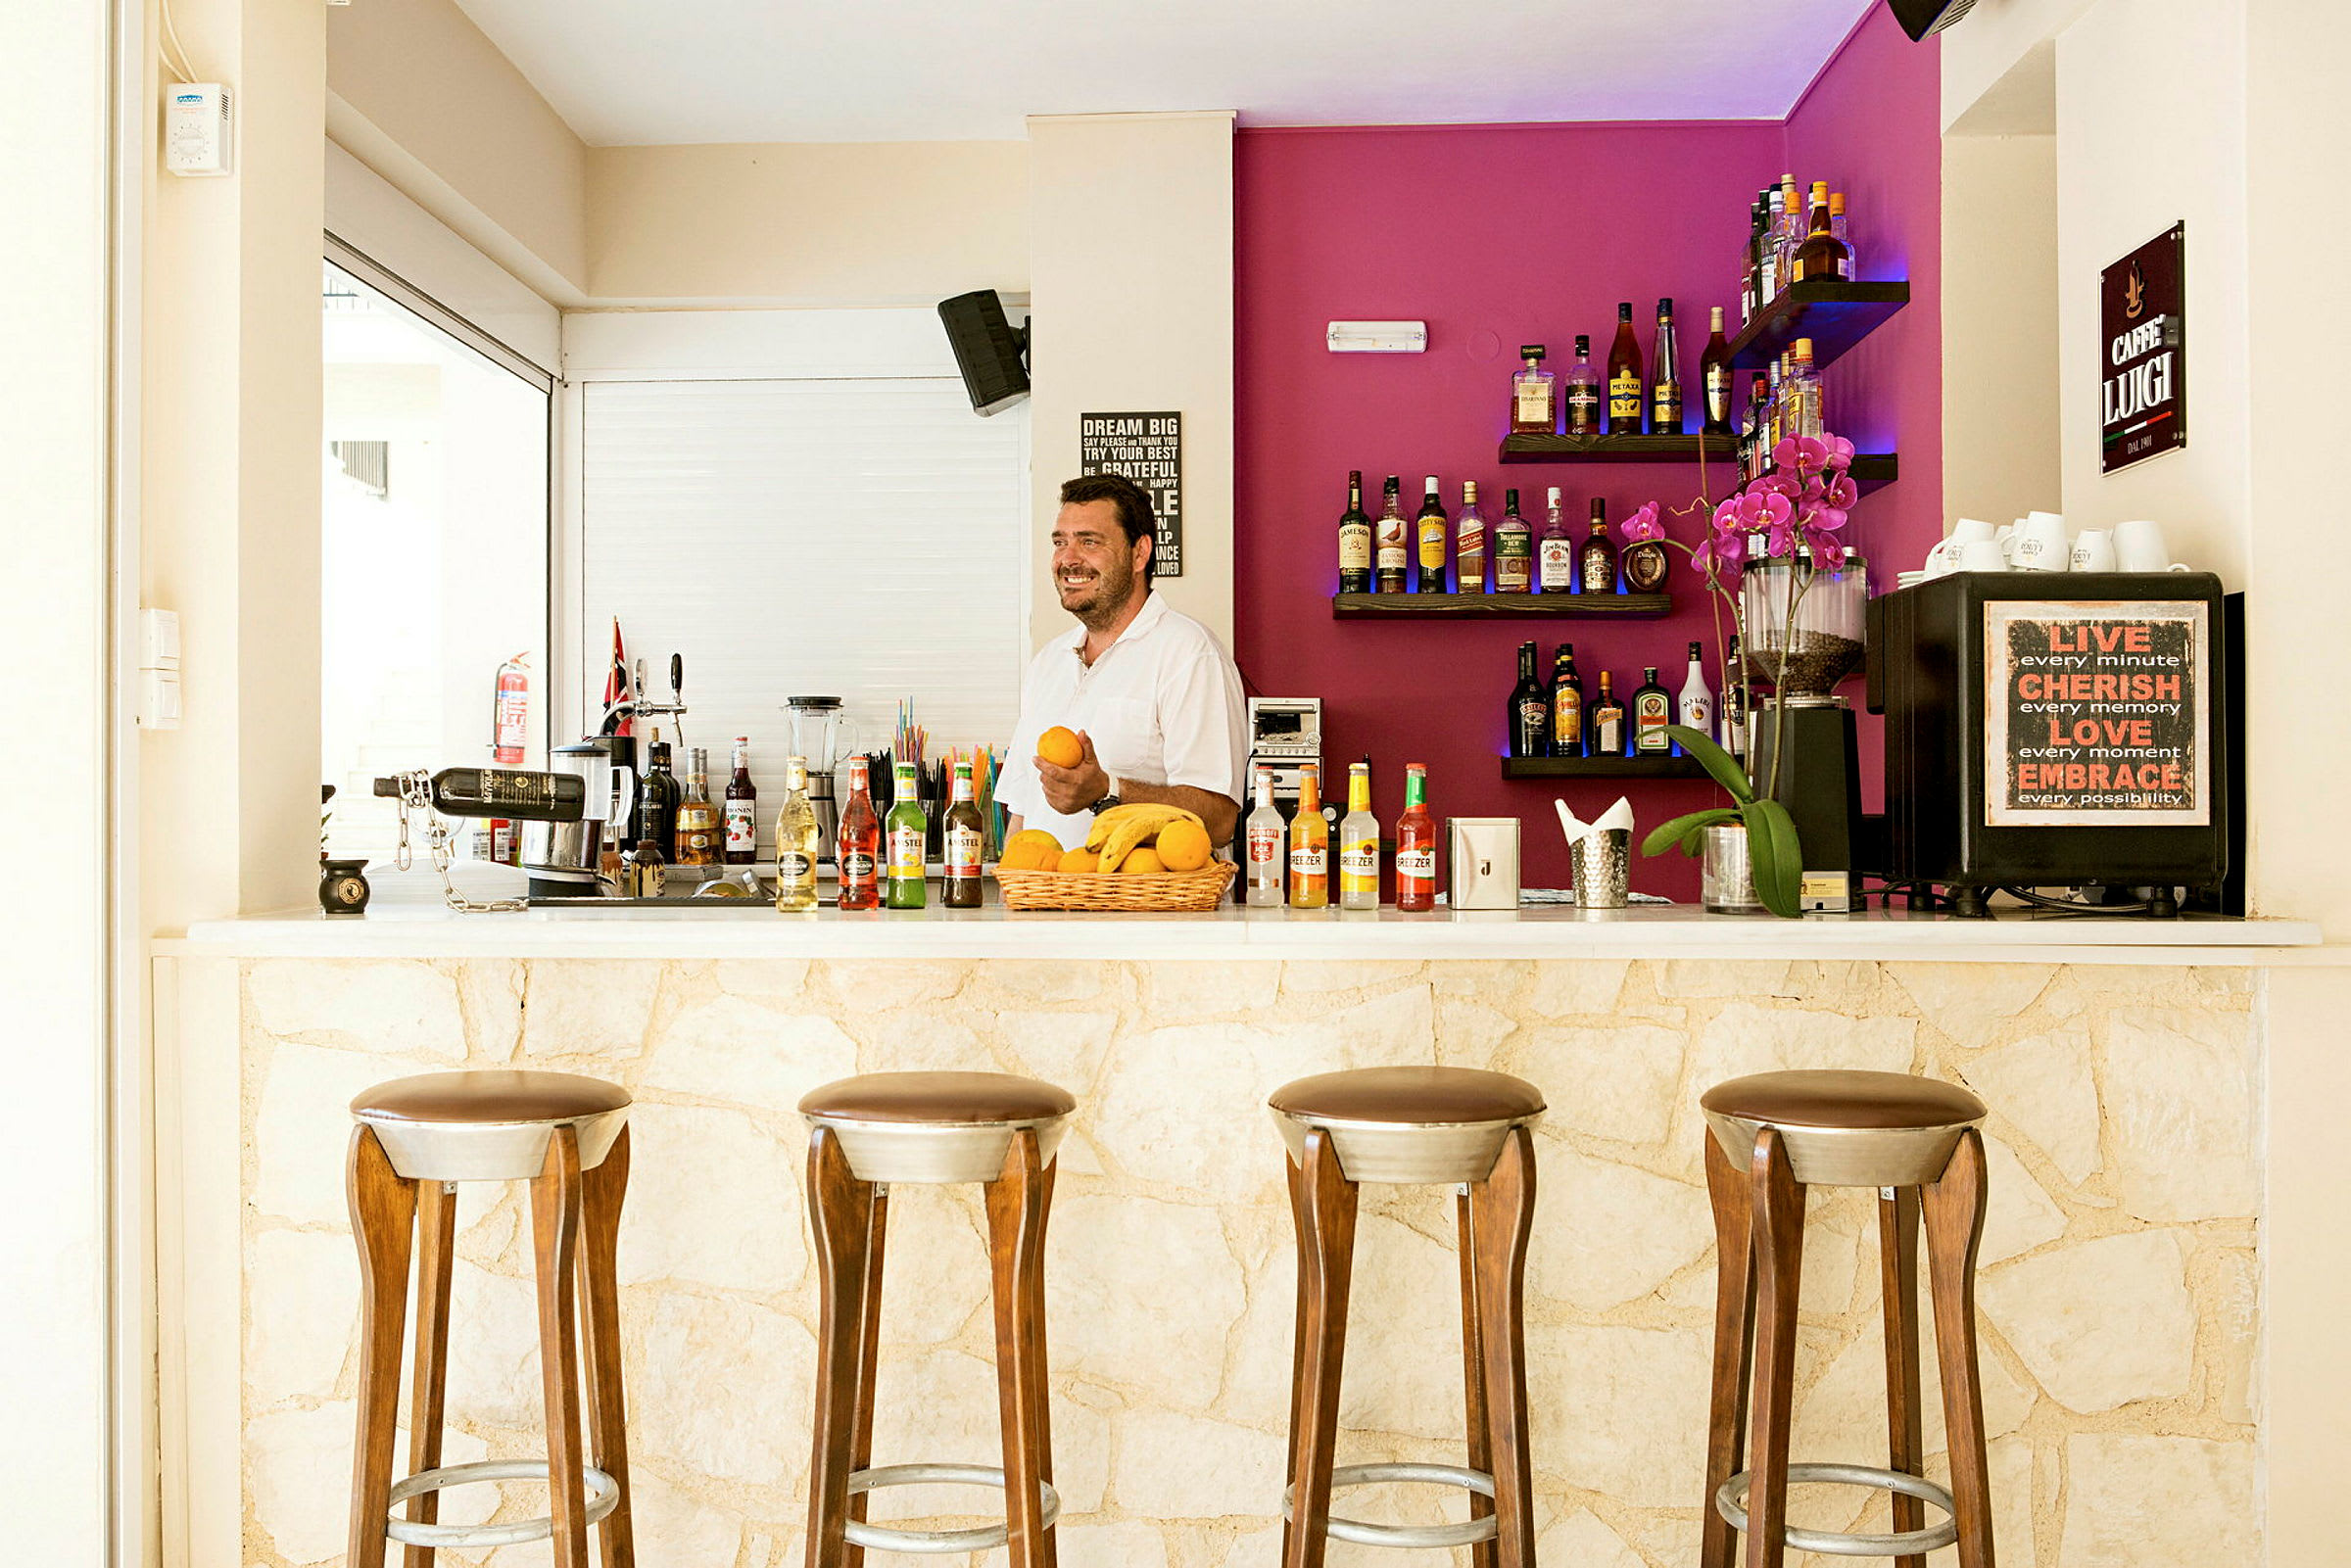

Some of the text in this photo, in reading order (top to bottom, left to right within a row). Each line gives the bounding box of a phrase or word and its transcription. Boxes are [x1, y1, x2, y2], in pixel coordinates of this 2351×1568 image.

[2103, 352, 2174, 427] LUIGI
[1083, 418, 1178, 437] DREAM BIG
[1083, 437, 1099, 447] SAY
[1100, 437, 1128, 447] PLEASE
[1138, 437, 1162, 446] THANK
[1163, 436, 1178, 446] YOU
[2127, 439, 2140, 454] DAL
[1083, 446, 1178, 460] TRY YOUR BEST
[1083, 461, 1178, 478] BE GRATEFUL
[1149, 478, 1178, 489] HAPPY
[1340, 528, 1369, 540] JAMESON
[1156, 546, 1178, 560] ANCE
[1157, 561, 1179, 575] LOVED
[2048, 626, 2152, 653] LIVE
[2020, 654, 2181, 668] every minute
[2018, 673, 2181, 700] CHERISH
[2020, 703, 2182, 716] every memory
[2050, 719, 2152, 746] LOVE
[2019, 746, 2182, 760] every moment
[2018, 764, 2182, 789] EMBRACE
[2018, 794, 2074, 805] every
